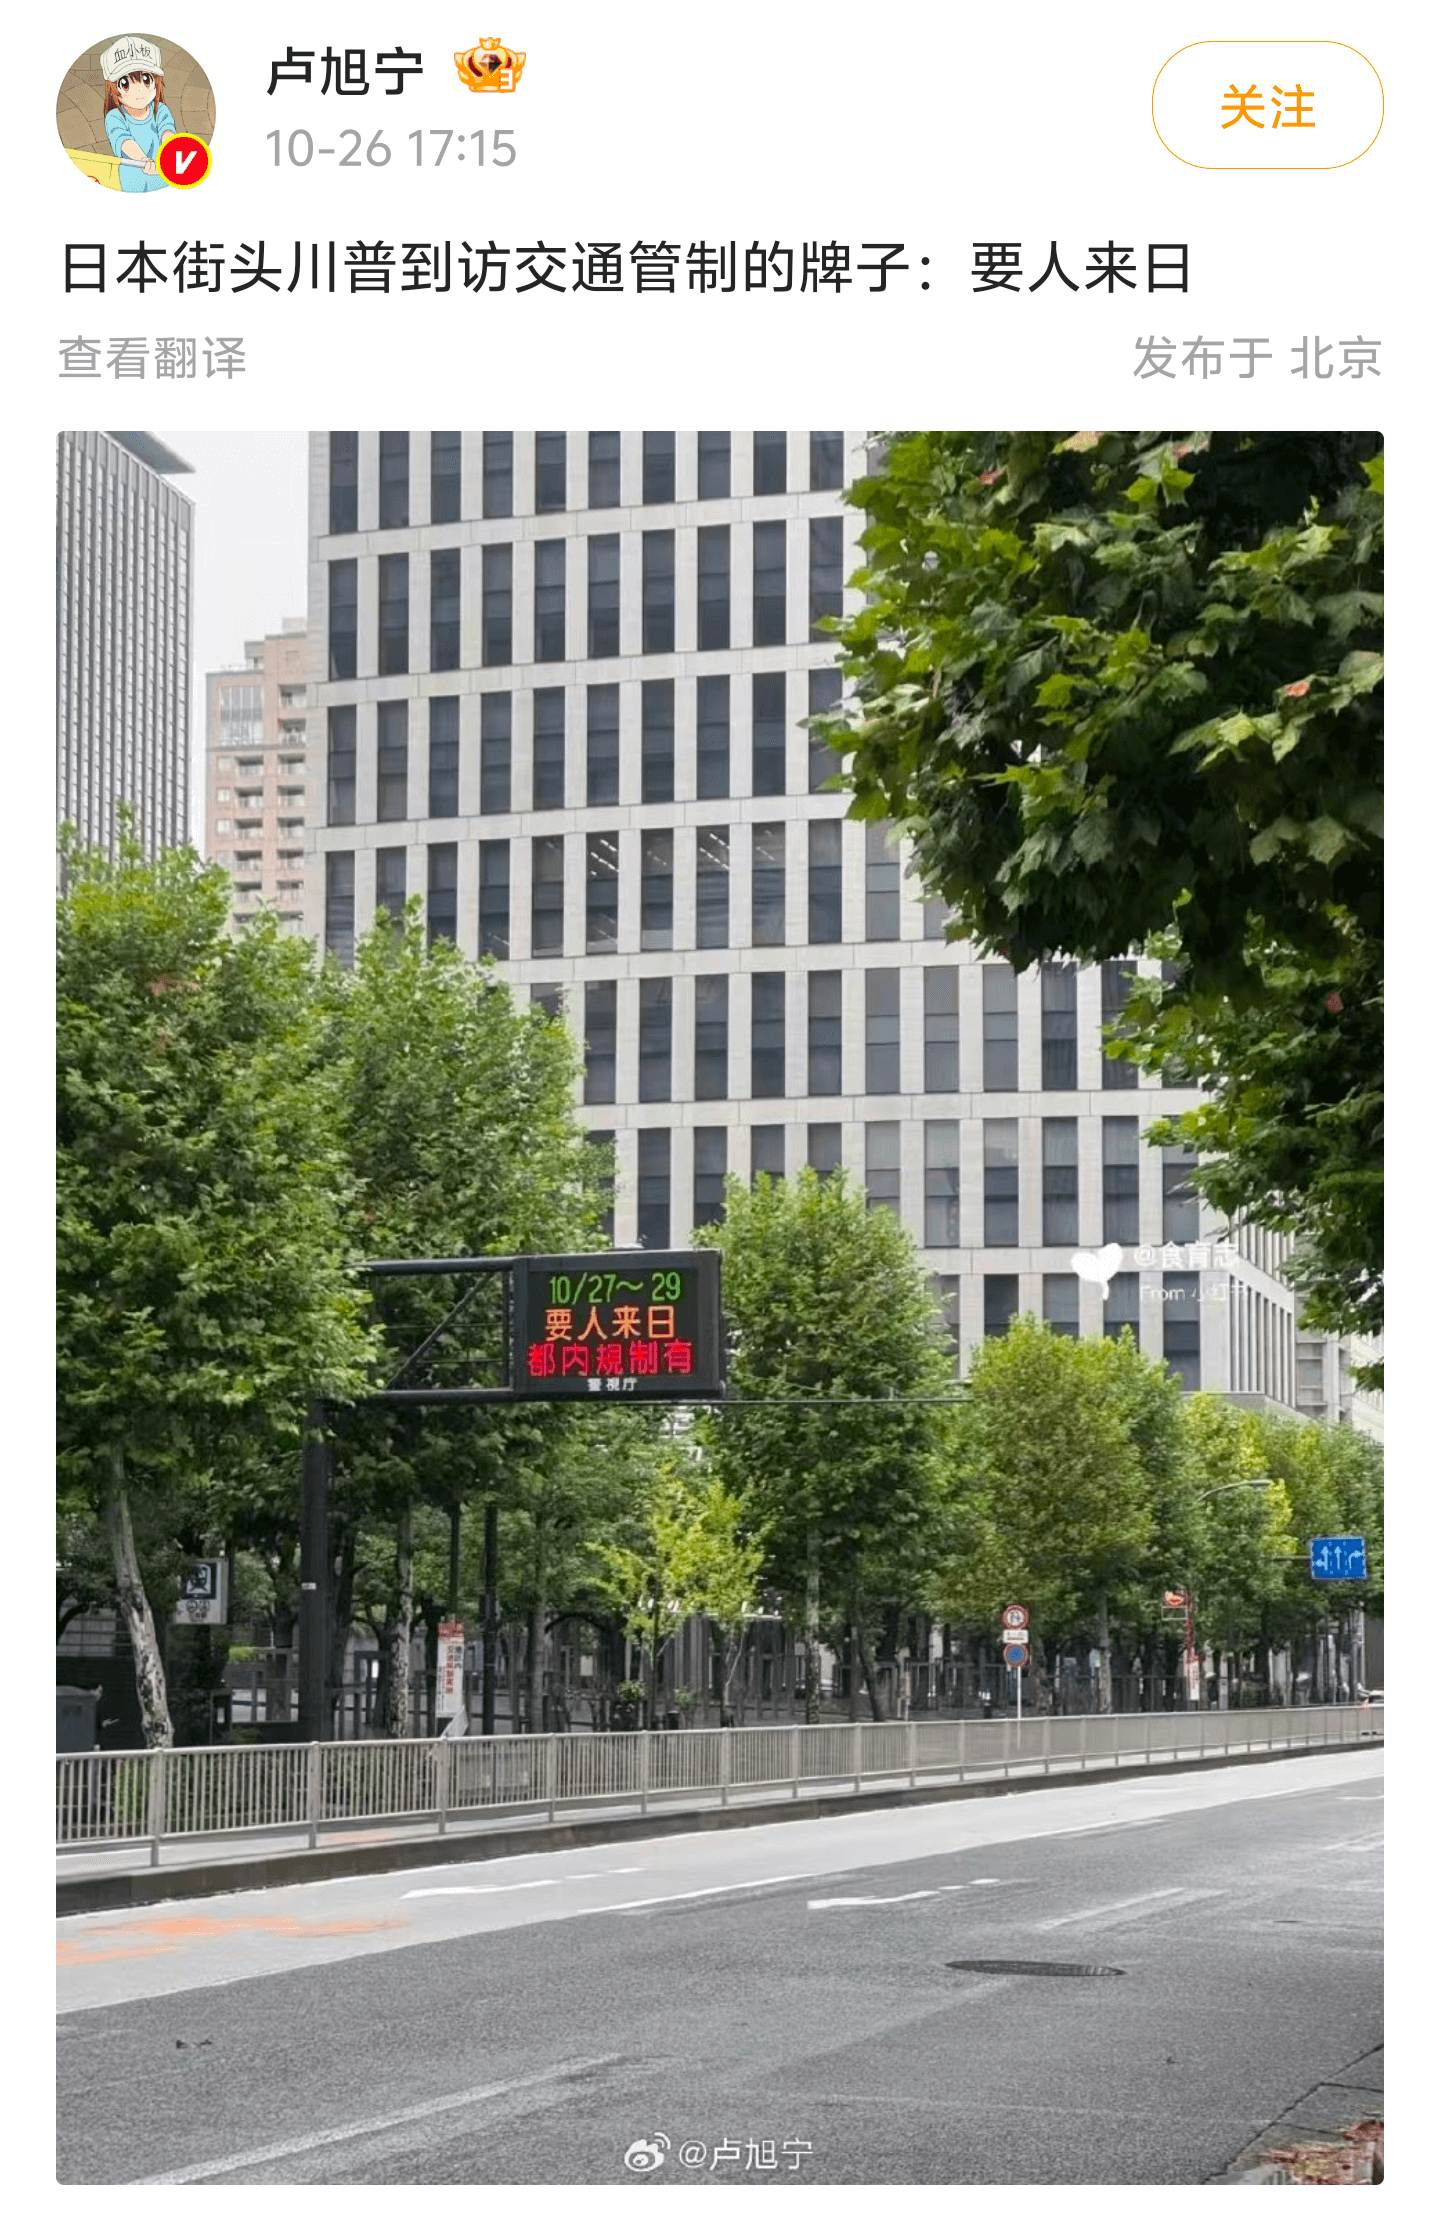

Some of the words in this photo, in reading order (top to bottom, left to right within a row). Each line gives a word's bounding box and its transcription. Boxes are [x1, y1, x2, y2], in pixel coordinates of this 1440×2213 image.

[545, 1305, 675, 1341] 要人来日
[528, 1340, 693, 1376] 都内規制有
